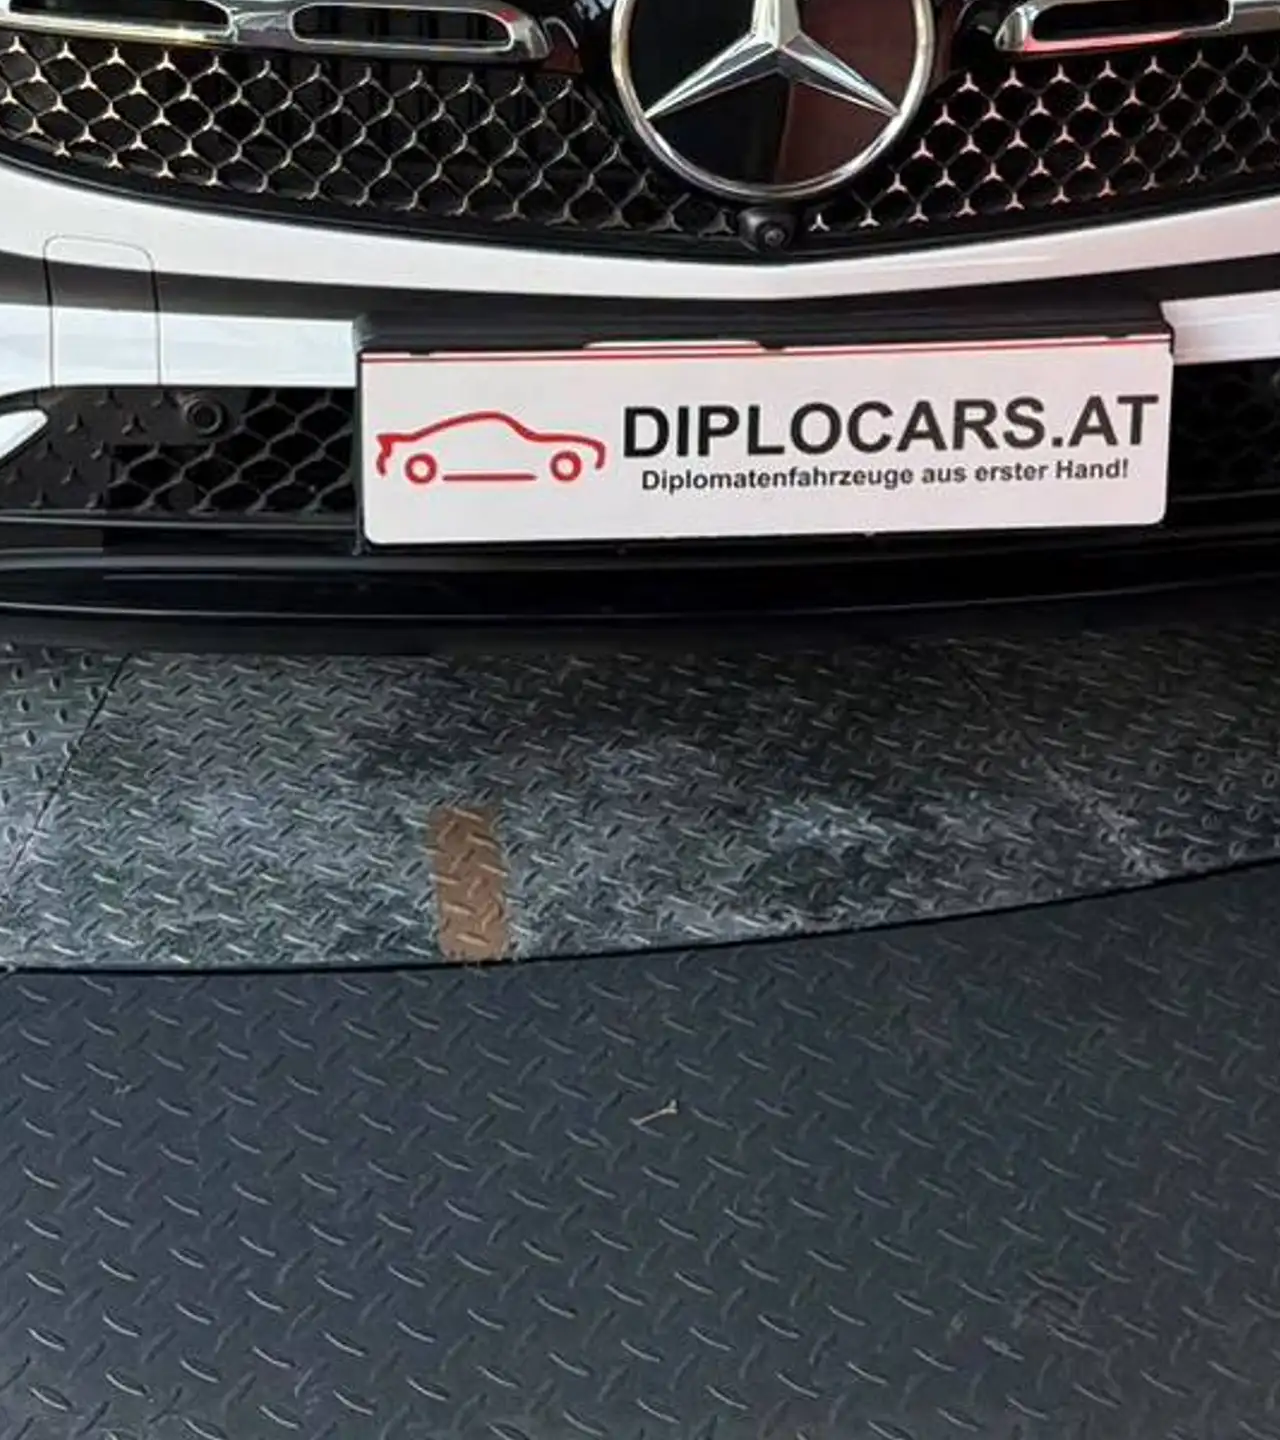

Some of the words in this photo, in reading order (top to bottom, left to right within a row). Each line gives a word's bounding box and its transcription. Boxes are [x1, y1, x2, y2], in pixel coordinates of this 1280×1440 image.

[622, 393, 1160, 459] DIPLOCARS.AT
[640, 463, 915, 493] Diplomatenfahrzeuge
[922, 464, 967, 484] aus
[974, 461, 1050, 483] erster
[1055, 457, 1130, 482] Hand!
